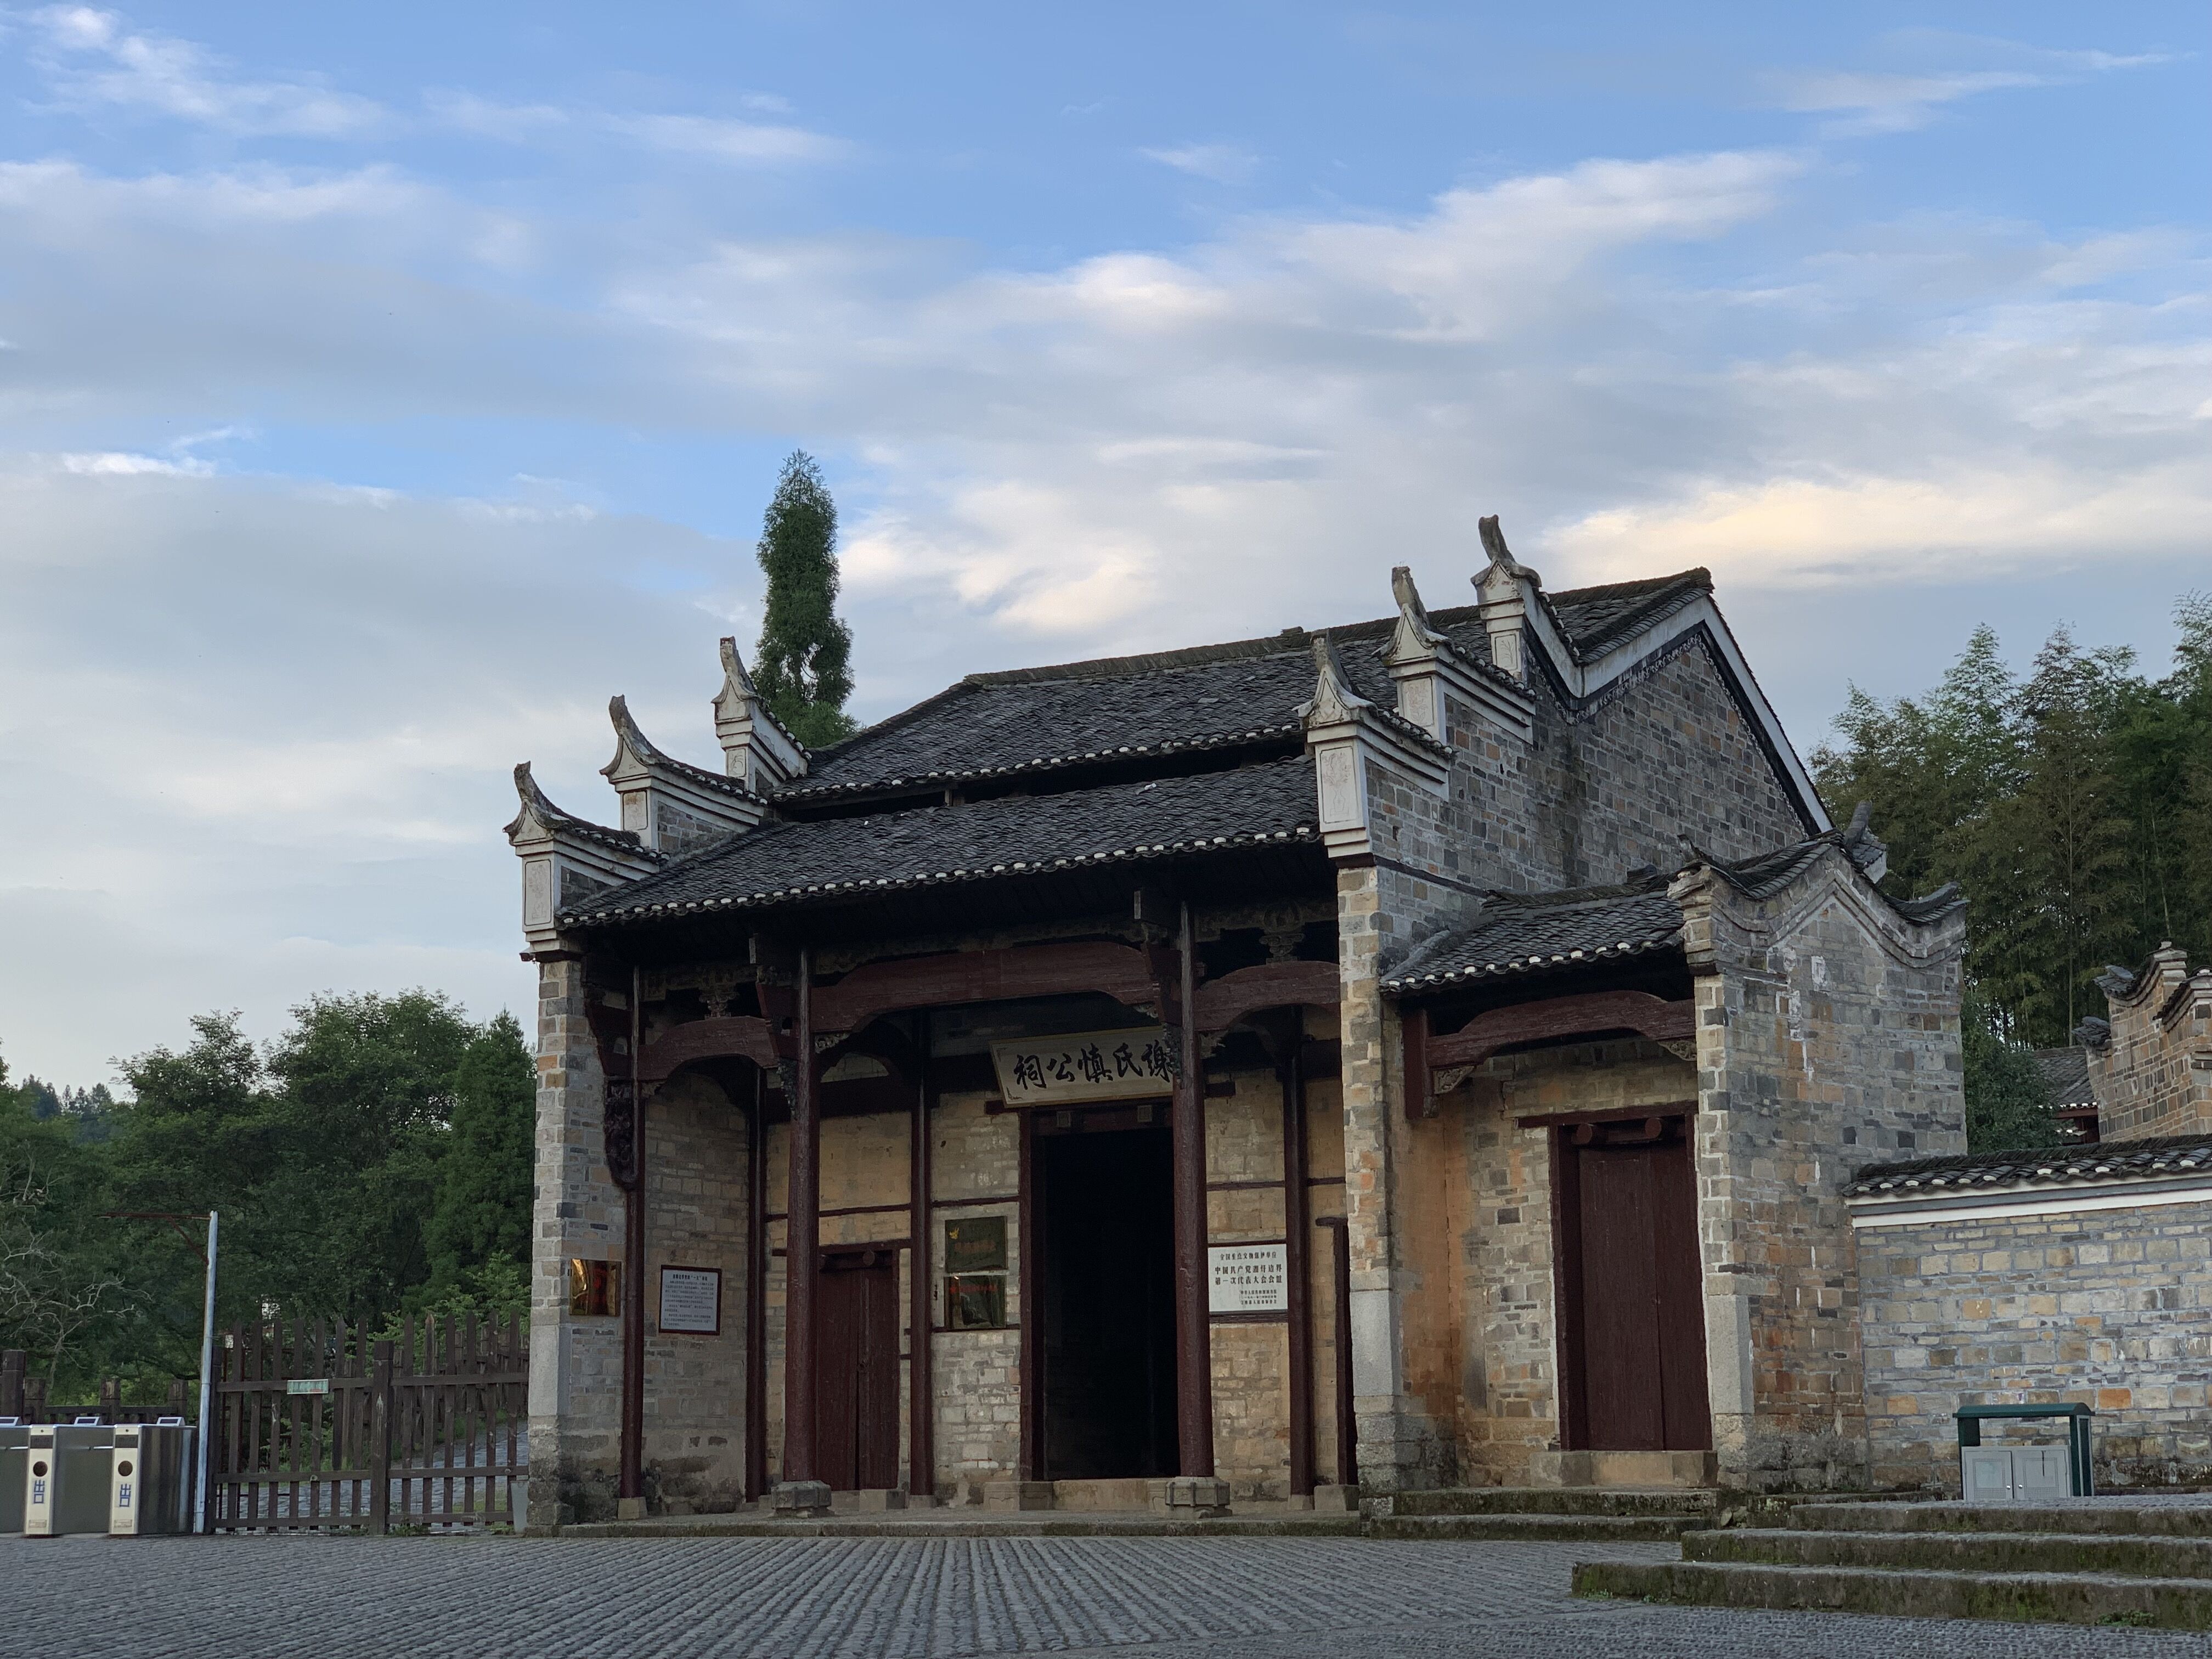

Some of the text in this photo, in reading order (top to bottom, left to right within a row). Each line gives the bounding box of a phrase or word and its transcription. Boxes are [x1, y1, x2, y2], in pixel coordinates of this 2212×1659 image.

[1220, 1251, 1277, 1261] 全国重点文物保护单位
[33, 1480, 45, 1504] 出口
[119, 1483, 132, 1508] 出口
